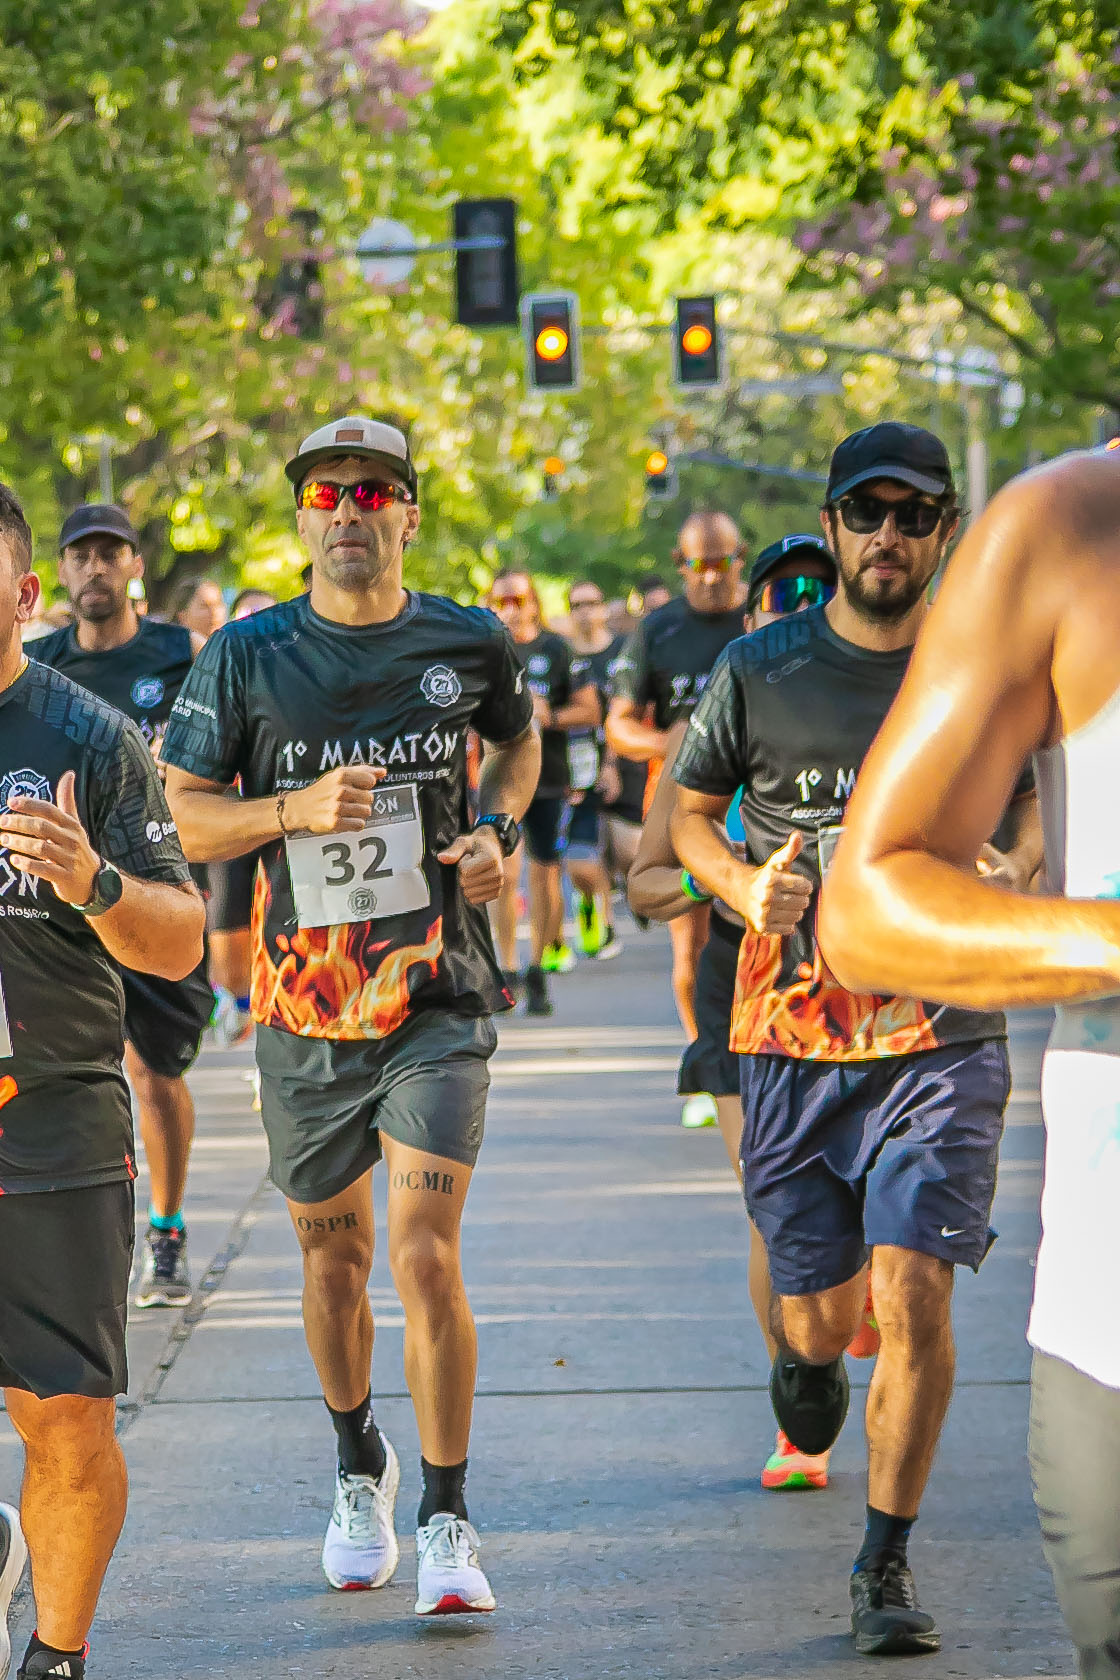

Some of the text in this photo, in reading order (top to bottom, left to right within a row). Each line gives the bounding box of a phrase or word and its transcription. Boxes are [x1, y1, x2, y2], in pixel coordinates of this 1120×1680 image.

[185, 697, 217, 719] MUNICIPAL
[283, 723, 458, 772] 1º MARATÓN
[795, 768, 822, 802] 1º
[322, 837, 393, 886] 32
